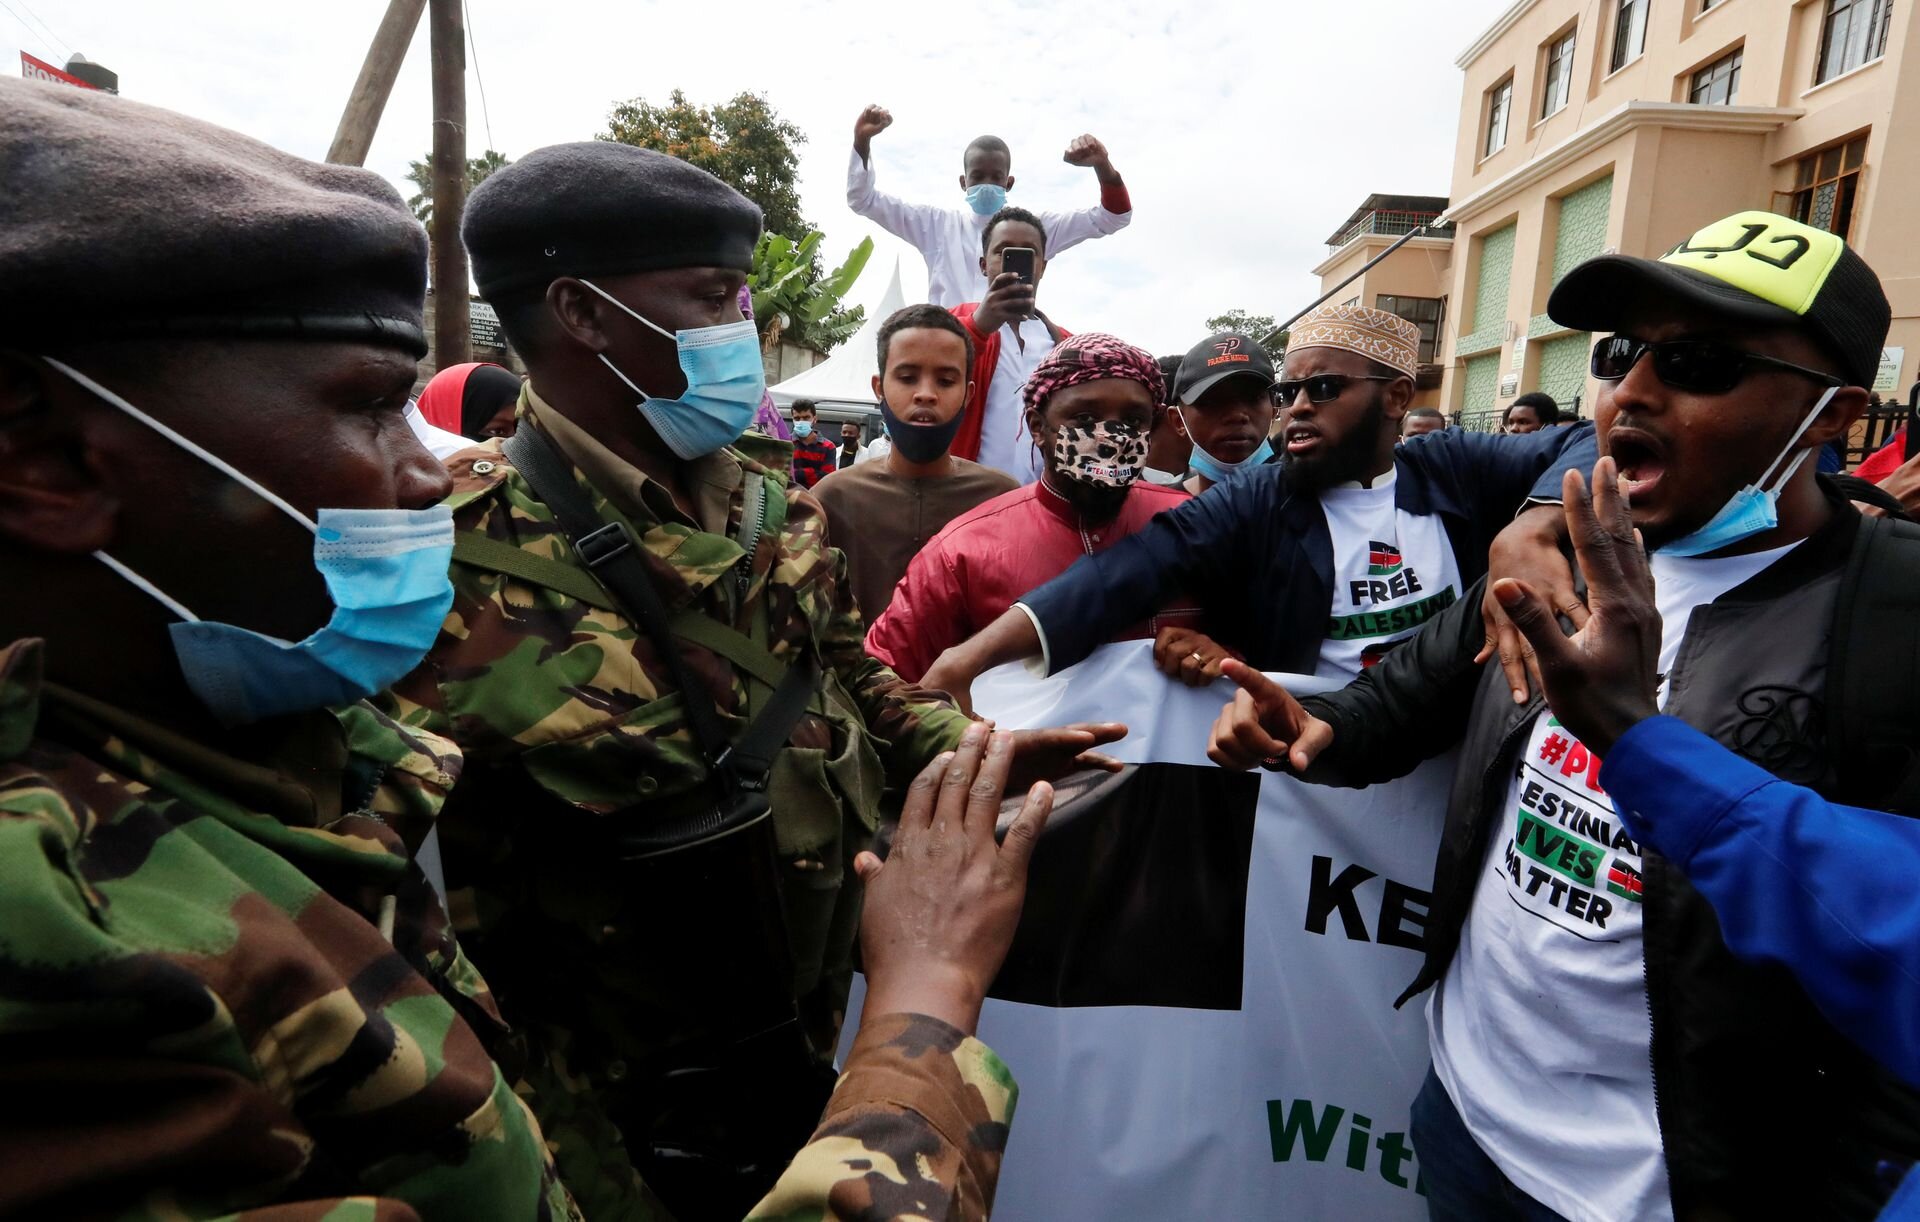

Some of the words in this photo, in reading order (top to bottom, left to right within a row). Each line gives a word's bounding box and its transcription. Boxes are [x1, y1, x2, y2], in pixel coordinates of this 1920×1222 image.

[1330, 588, 1455, 638] PALESTINE
[1349, 567, 1423, 606] FREE
[1516, 817, 1599, 881] IVES
[1304, 855, 1432, 953] KE
